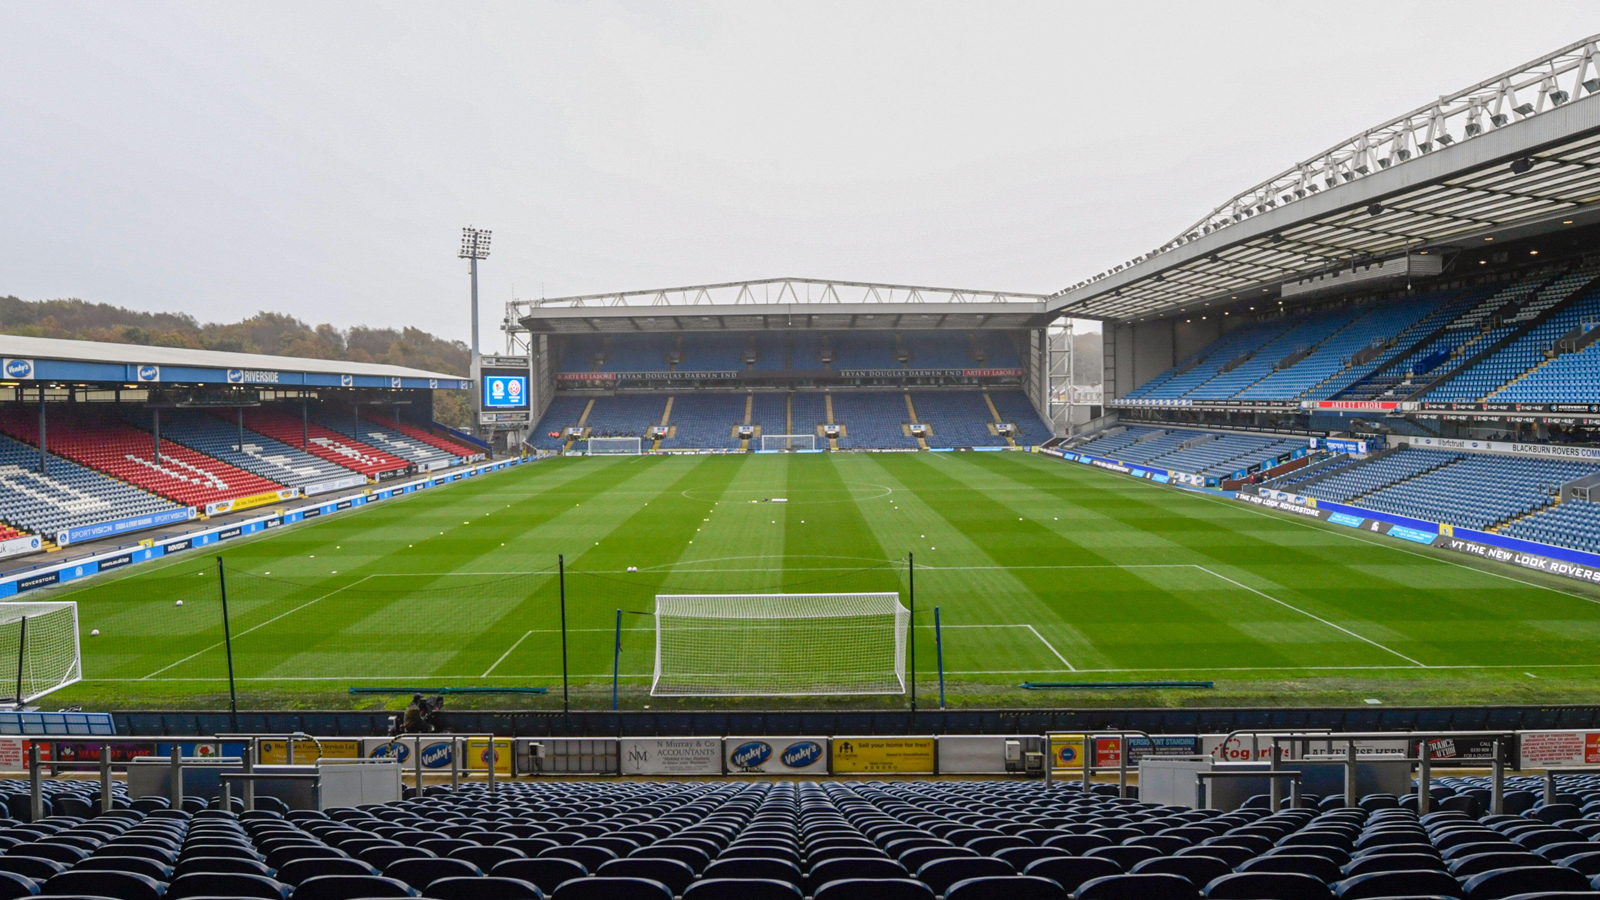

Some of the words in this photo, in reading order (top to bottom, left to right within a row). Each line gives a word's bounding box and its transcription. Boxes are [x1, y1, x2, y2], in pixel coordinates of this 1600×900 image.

[9, 361, 28, 374] Venky's
[142, 368, 156, 378] Venky's
[244, 370, 278, 382] RIVERSIDE
[1512, 444, 1550, 454] BLACKBURN
[1552, 447, 1580, 456] ROVERS
[1280, 502, 1320, 516] ROVERSTORE
[1466, 543, 1486, 554] THE
[1488, 548, 1512, 560] NEW
[1515, 554, 1547, 568] LOOK
[1550, 562, 1600, 581] ROVERS
[21, 575, 56, 588] ROVERSTORE
[735, 744, 766, 764] Venky's
[785, 744, 817, 764] Venky's
